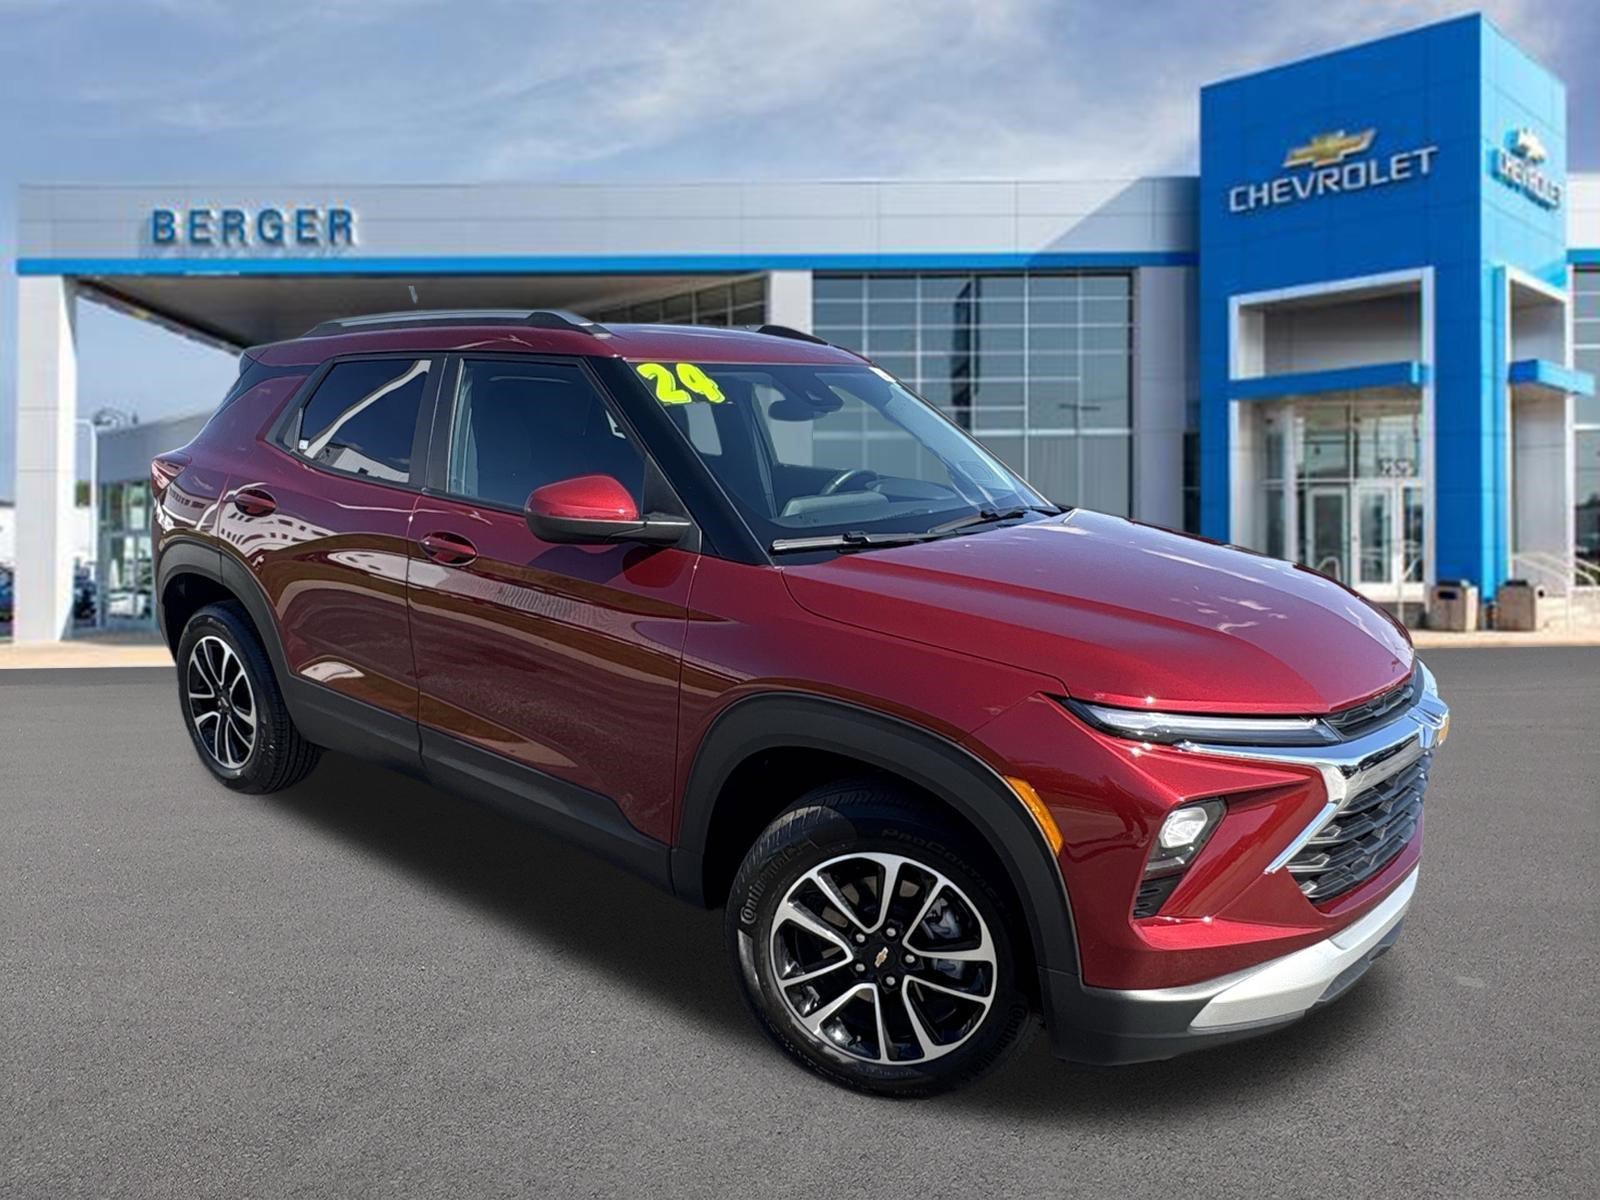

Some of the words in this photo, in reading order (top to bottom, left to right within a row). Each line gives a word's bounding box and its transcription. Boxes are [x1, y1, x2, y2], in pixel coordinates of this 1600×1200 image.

[1229, 146, 1437, 212] CHEVROLET
[152, 208, 355, 247] BERGER
[636, 363, 725, 404] 24
